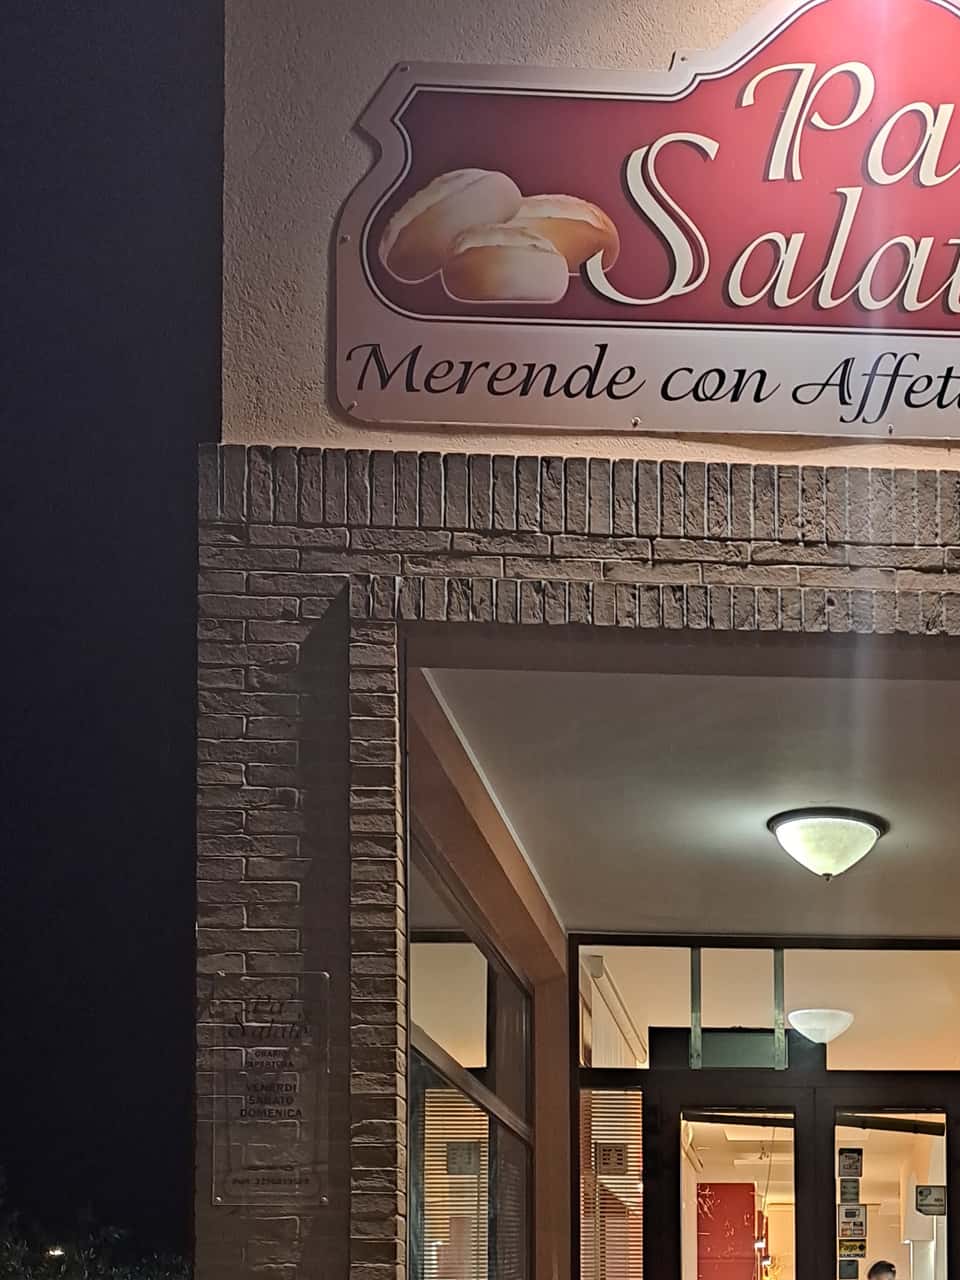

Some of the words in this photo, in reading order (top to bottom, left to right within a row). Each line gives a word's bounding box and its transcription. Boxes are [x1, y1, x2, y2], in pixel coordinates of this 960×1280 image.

[346, 343, 645, 399] Merende
[660, 364, 780, 403] con
[240, 1109, 302, 1118] DOMENICA
